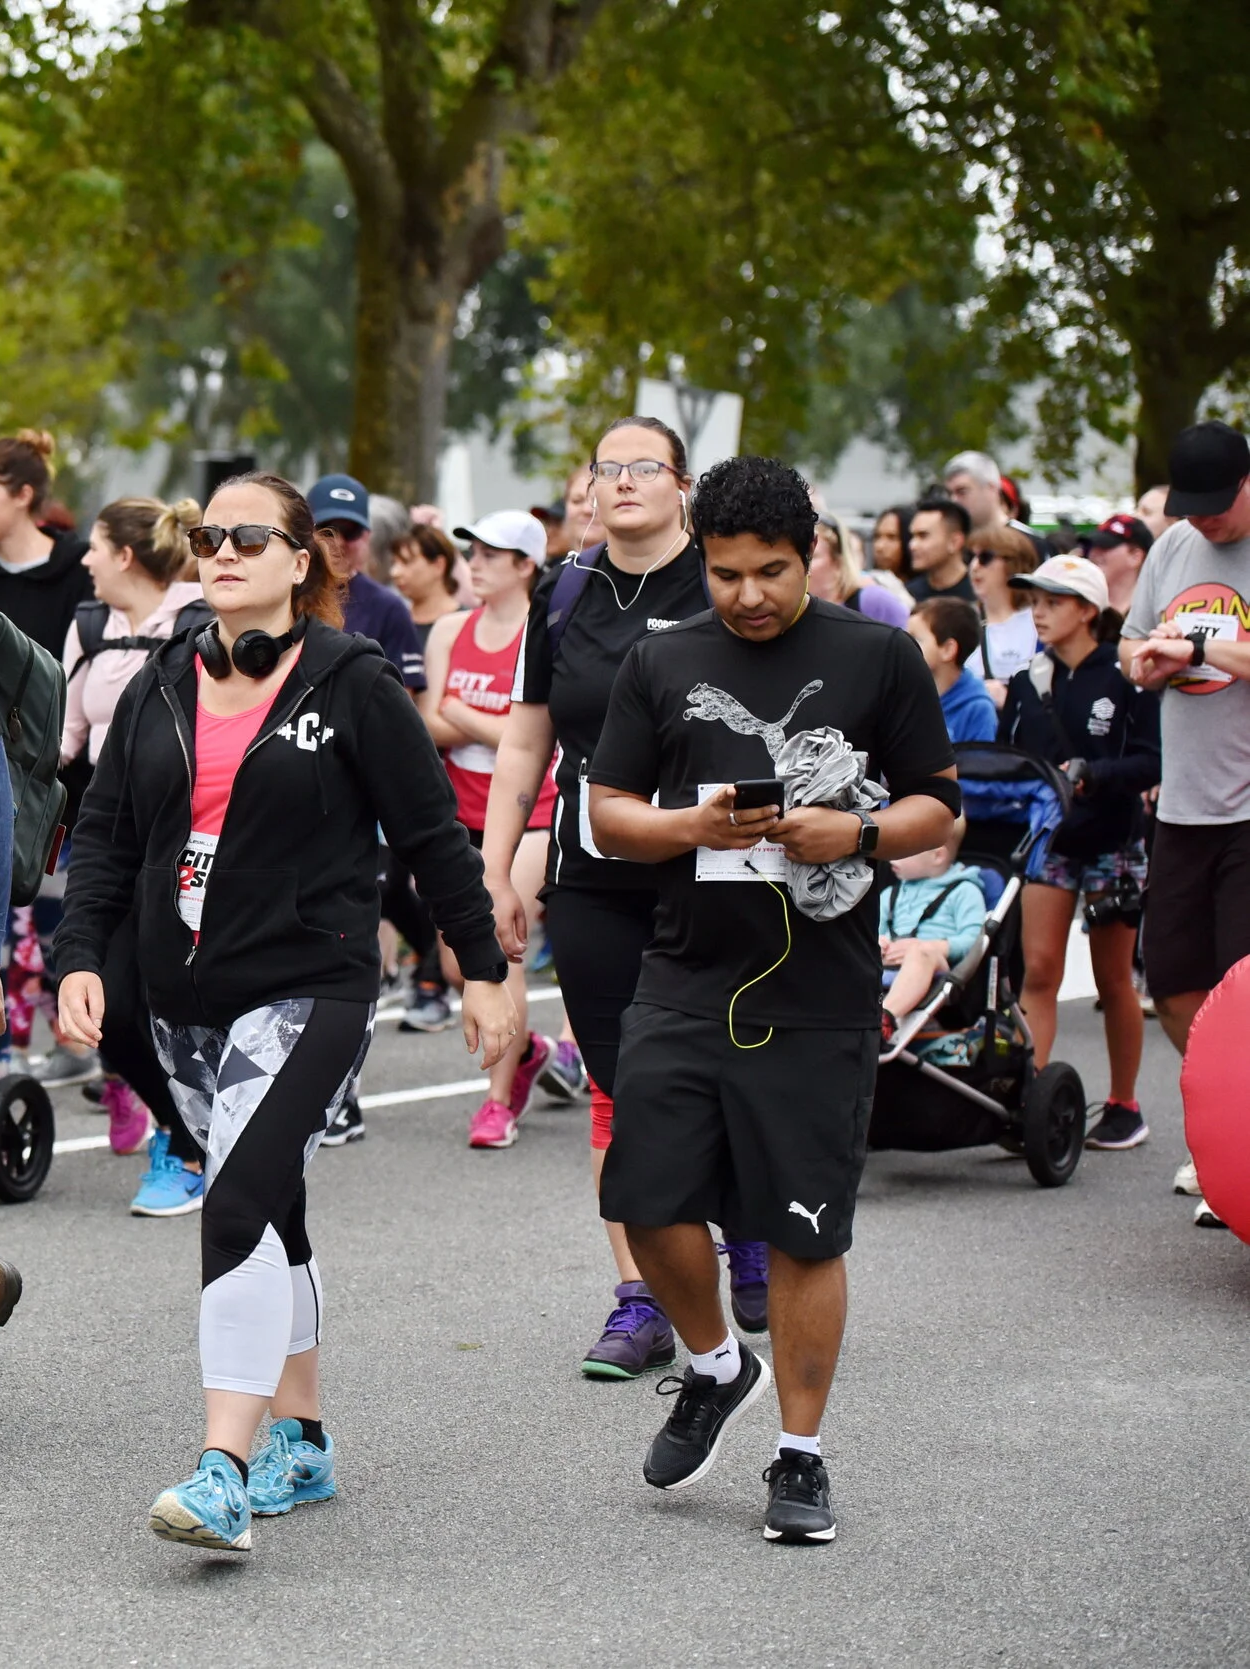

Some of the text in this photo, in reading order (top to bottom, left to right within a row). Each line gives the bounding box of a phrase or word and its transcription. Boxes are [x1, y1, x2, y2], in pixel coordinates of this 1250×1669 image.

[447, 670, 496, 692] CITY
[460, 690, 511, 712] SURF
[179, 849, 214, 871] CIT
